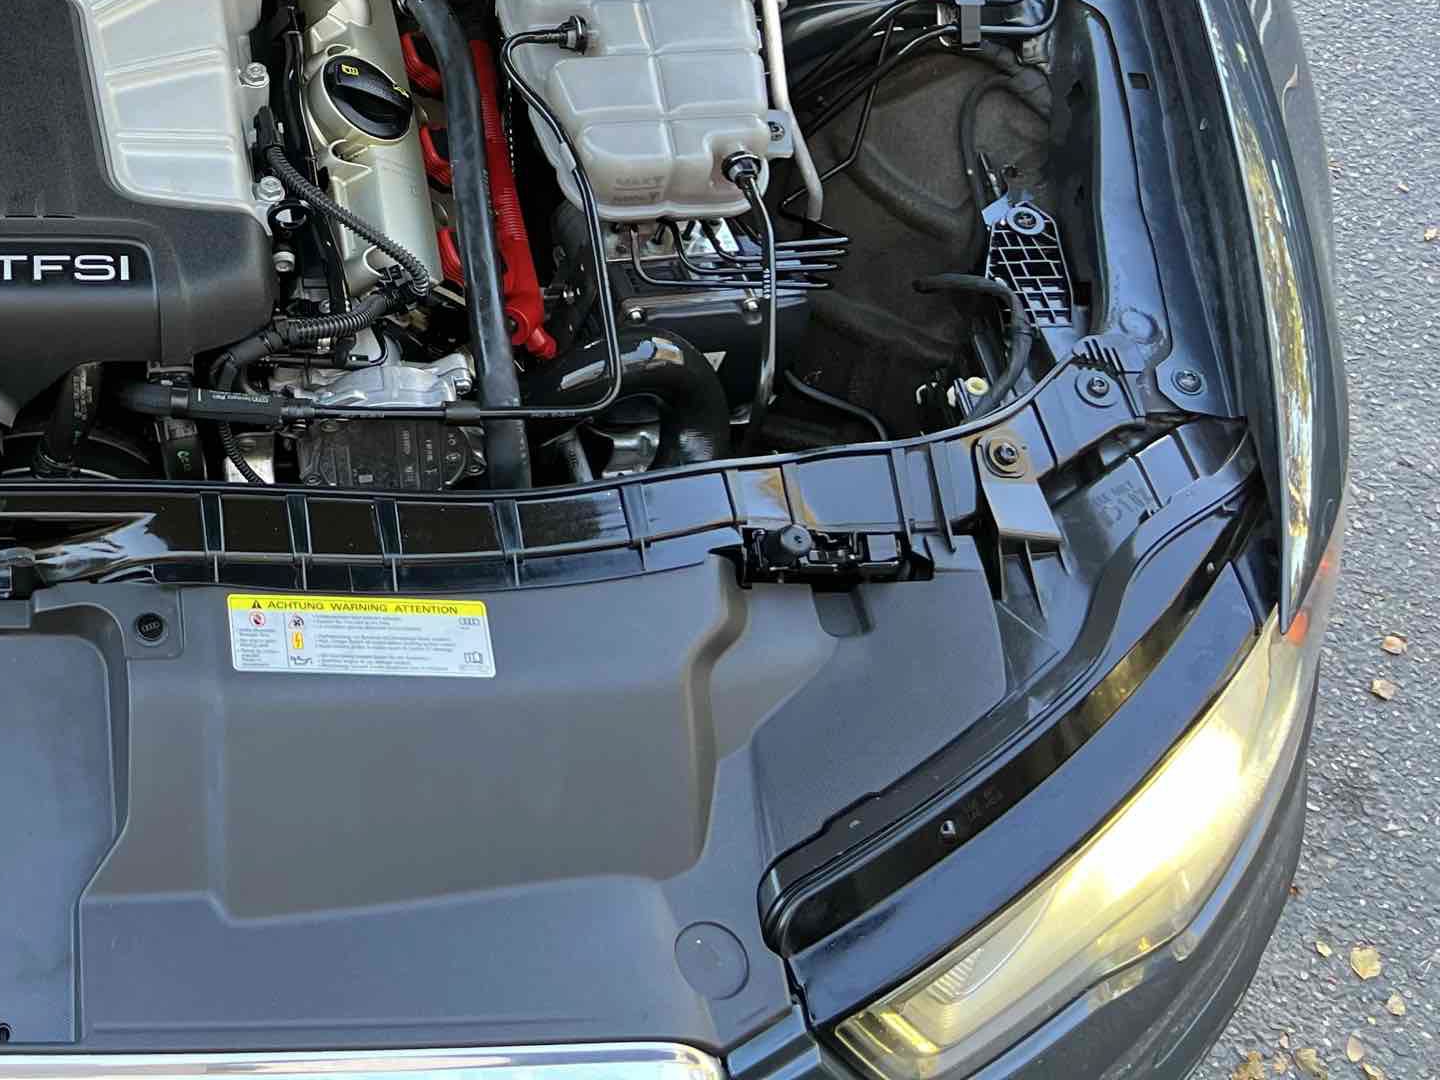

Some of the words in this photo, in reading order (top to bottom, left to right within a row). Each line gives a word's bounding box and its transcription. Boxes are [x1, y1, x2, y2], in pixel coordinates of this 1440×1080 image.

[267, 599, 325, 611] ACHTUNG
[330, 602, 389, 612] WARNING
[394, 604, 459, 615] ATTENTION
